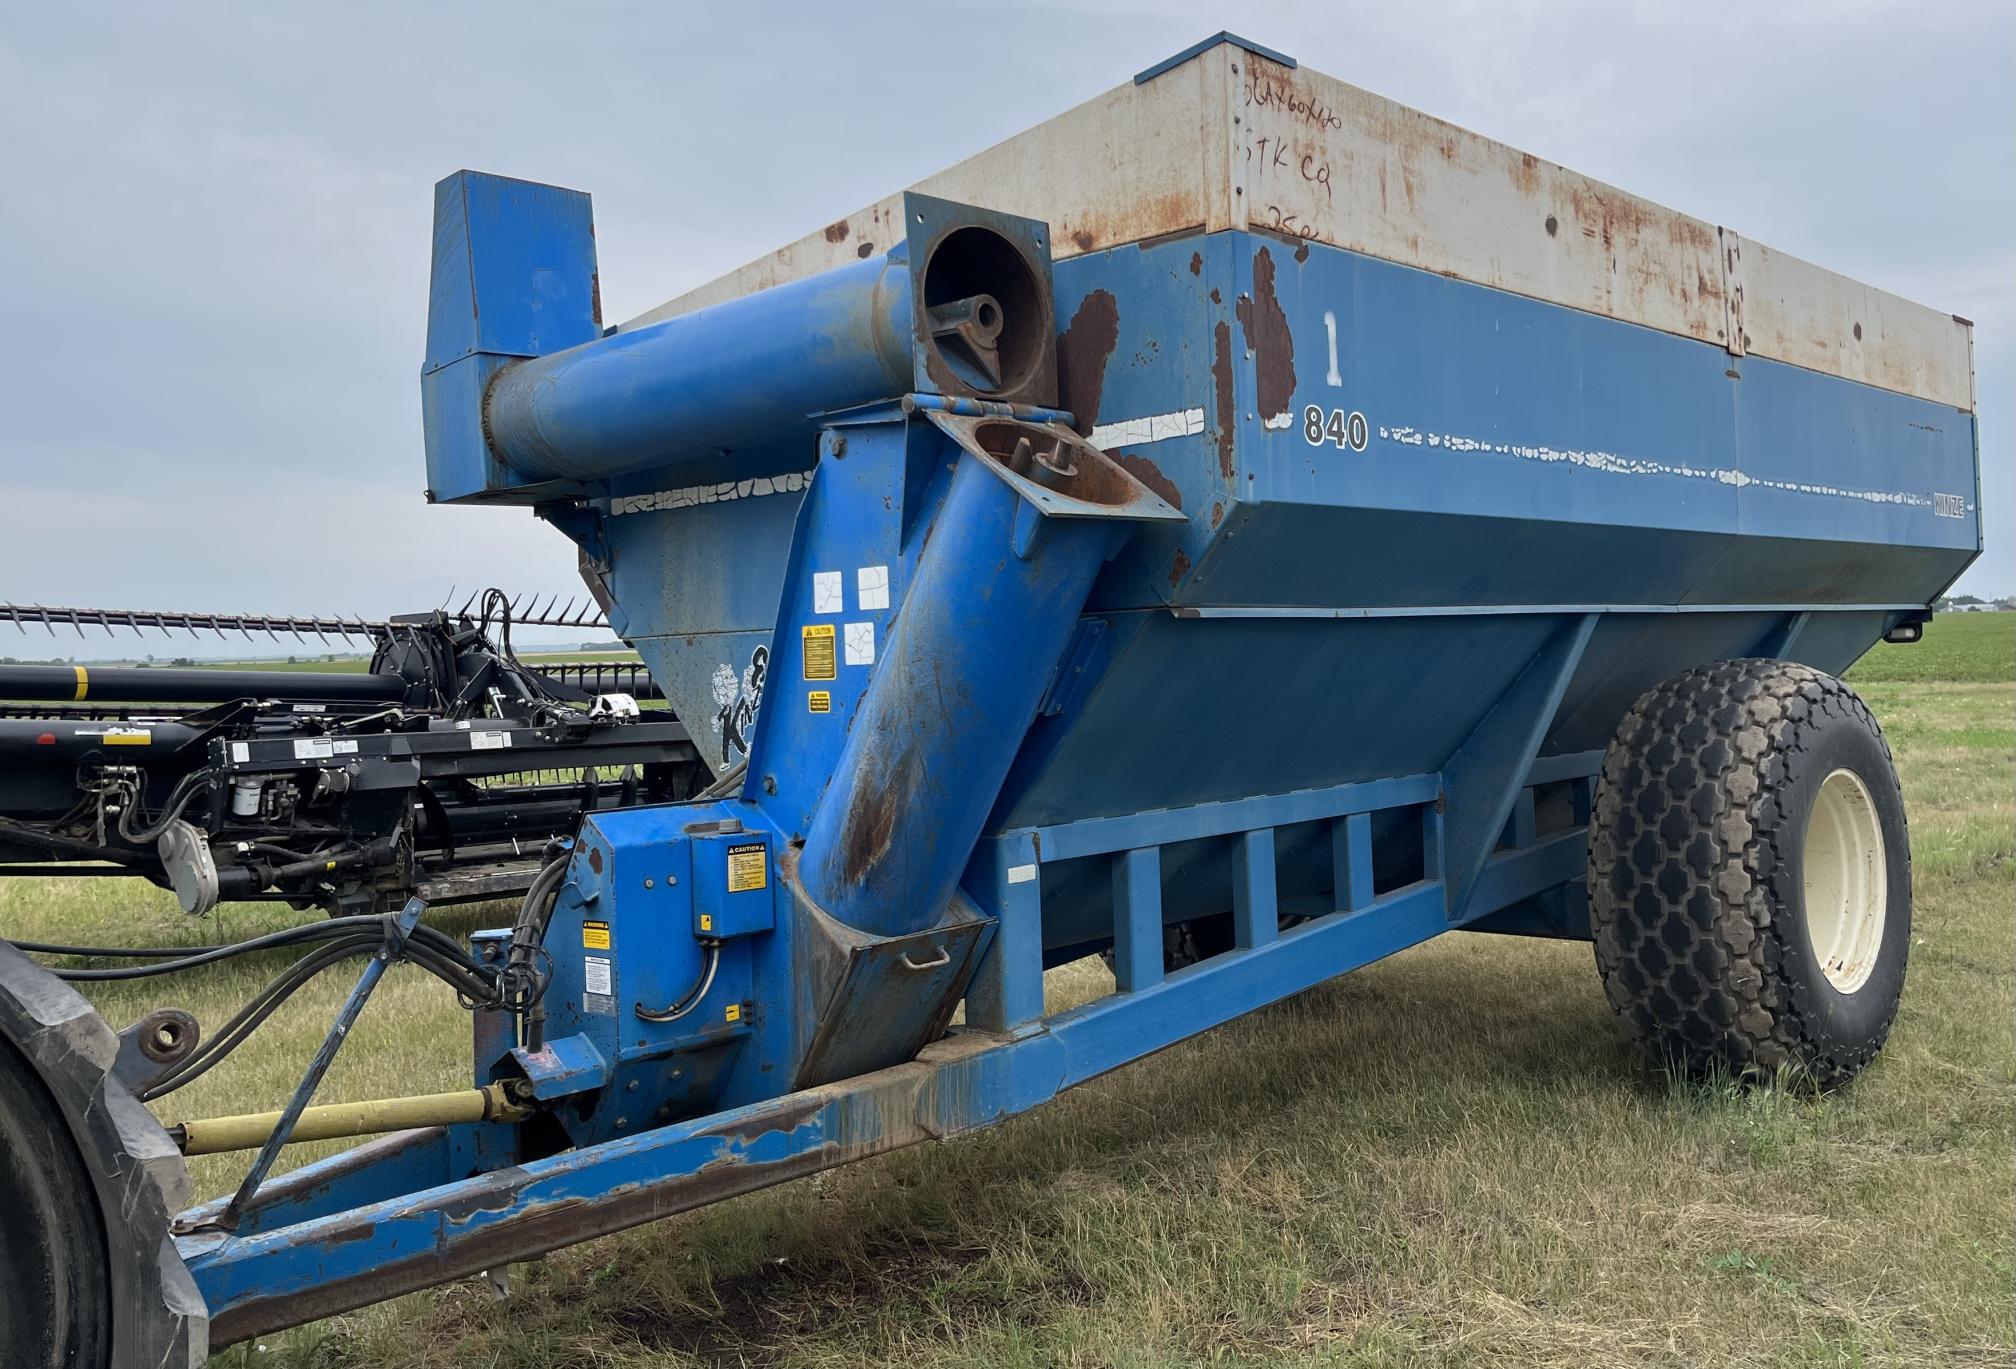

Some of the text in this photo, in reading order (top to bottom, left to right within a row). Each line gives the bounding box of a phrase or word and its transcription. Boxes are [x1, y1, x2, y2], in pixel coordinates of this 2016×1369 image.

[1303, 403, 1369, 453] 840
[1934, 491, 1965, 519] KINZE
[814, 627, 832, 635] CAUTION
[734, 844, 761, 854] CAUTION
[587, 921, 605, 930] WARNING
